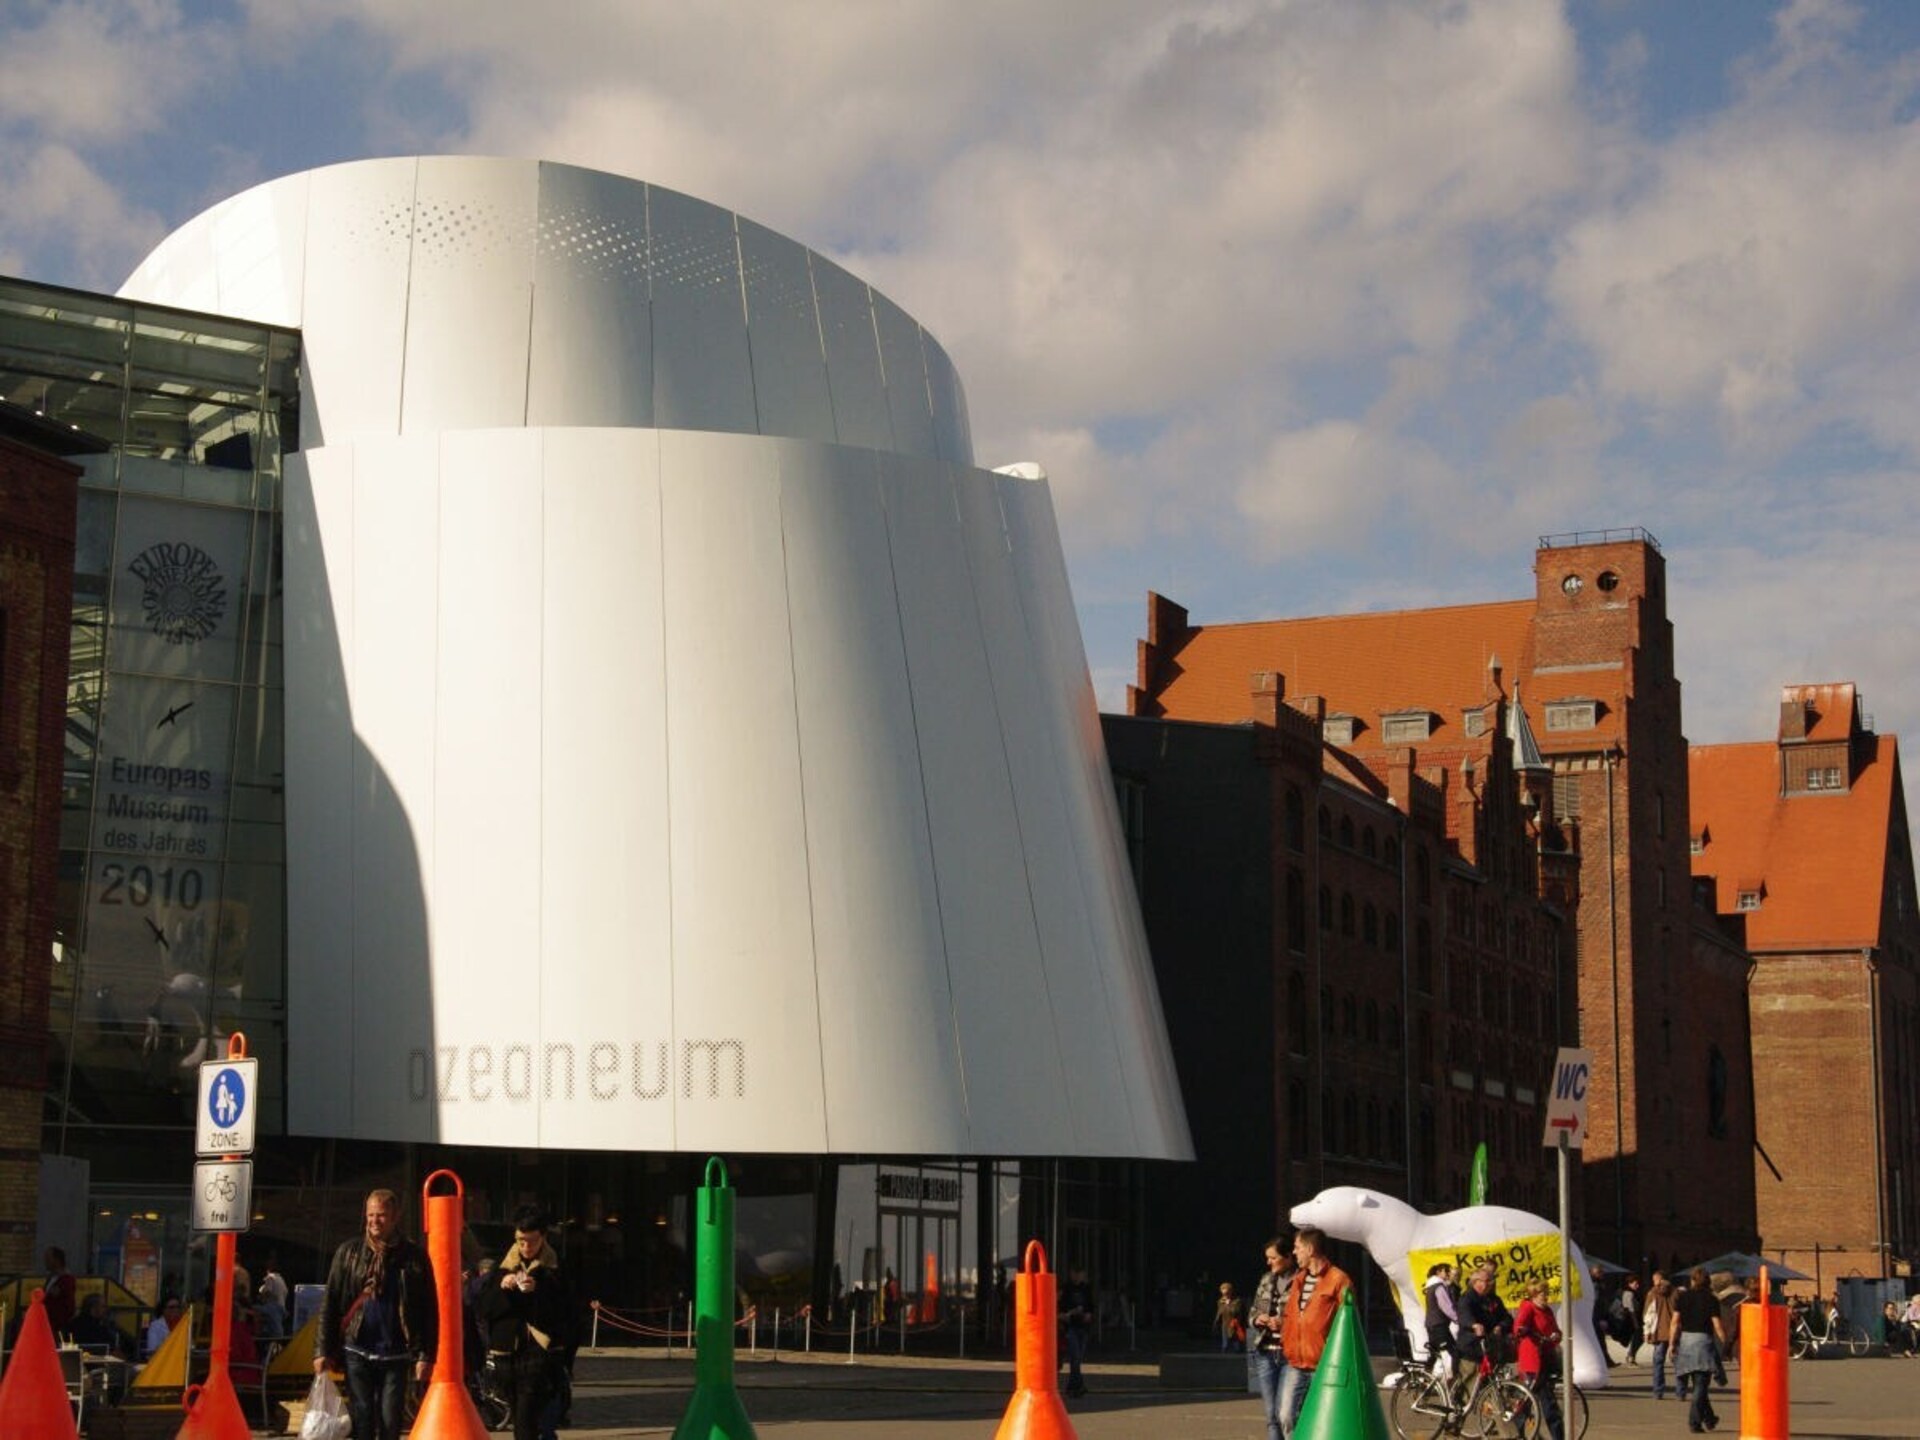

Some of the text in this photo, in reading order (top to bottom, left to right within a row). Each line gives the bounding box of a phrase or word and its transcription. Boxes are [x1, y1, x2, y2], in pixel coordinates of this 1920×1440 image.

[128, 541, 226, 605] EUROPEAN
[111, 756, 211, 791] Europas
[107, 793, 208, 824] Museum
[103, 829, 207, 855] des Jahres
[99, 863, 204, 911] 2010
[408, 1038, 746, 1102] ozeaneum
[1556, 1062, 1588, 1101] WC
[210, 1132, 239, 1148] ZONE
[210, 1211, 229, 1224] frei
[1456, 1241, 1531, 1269] Kein Öl
